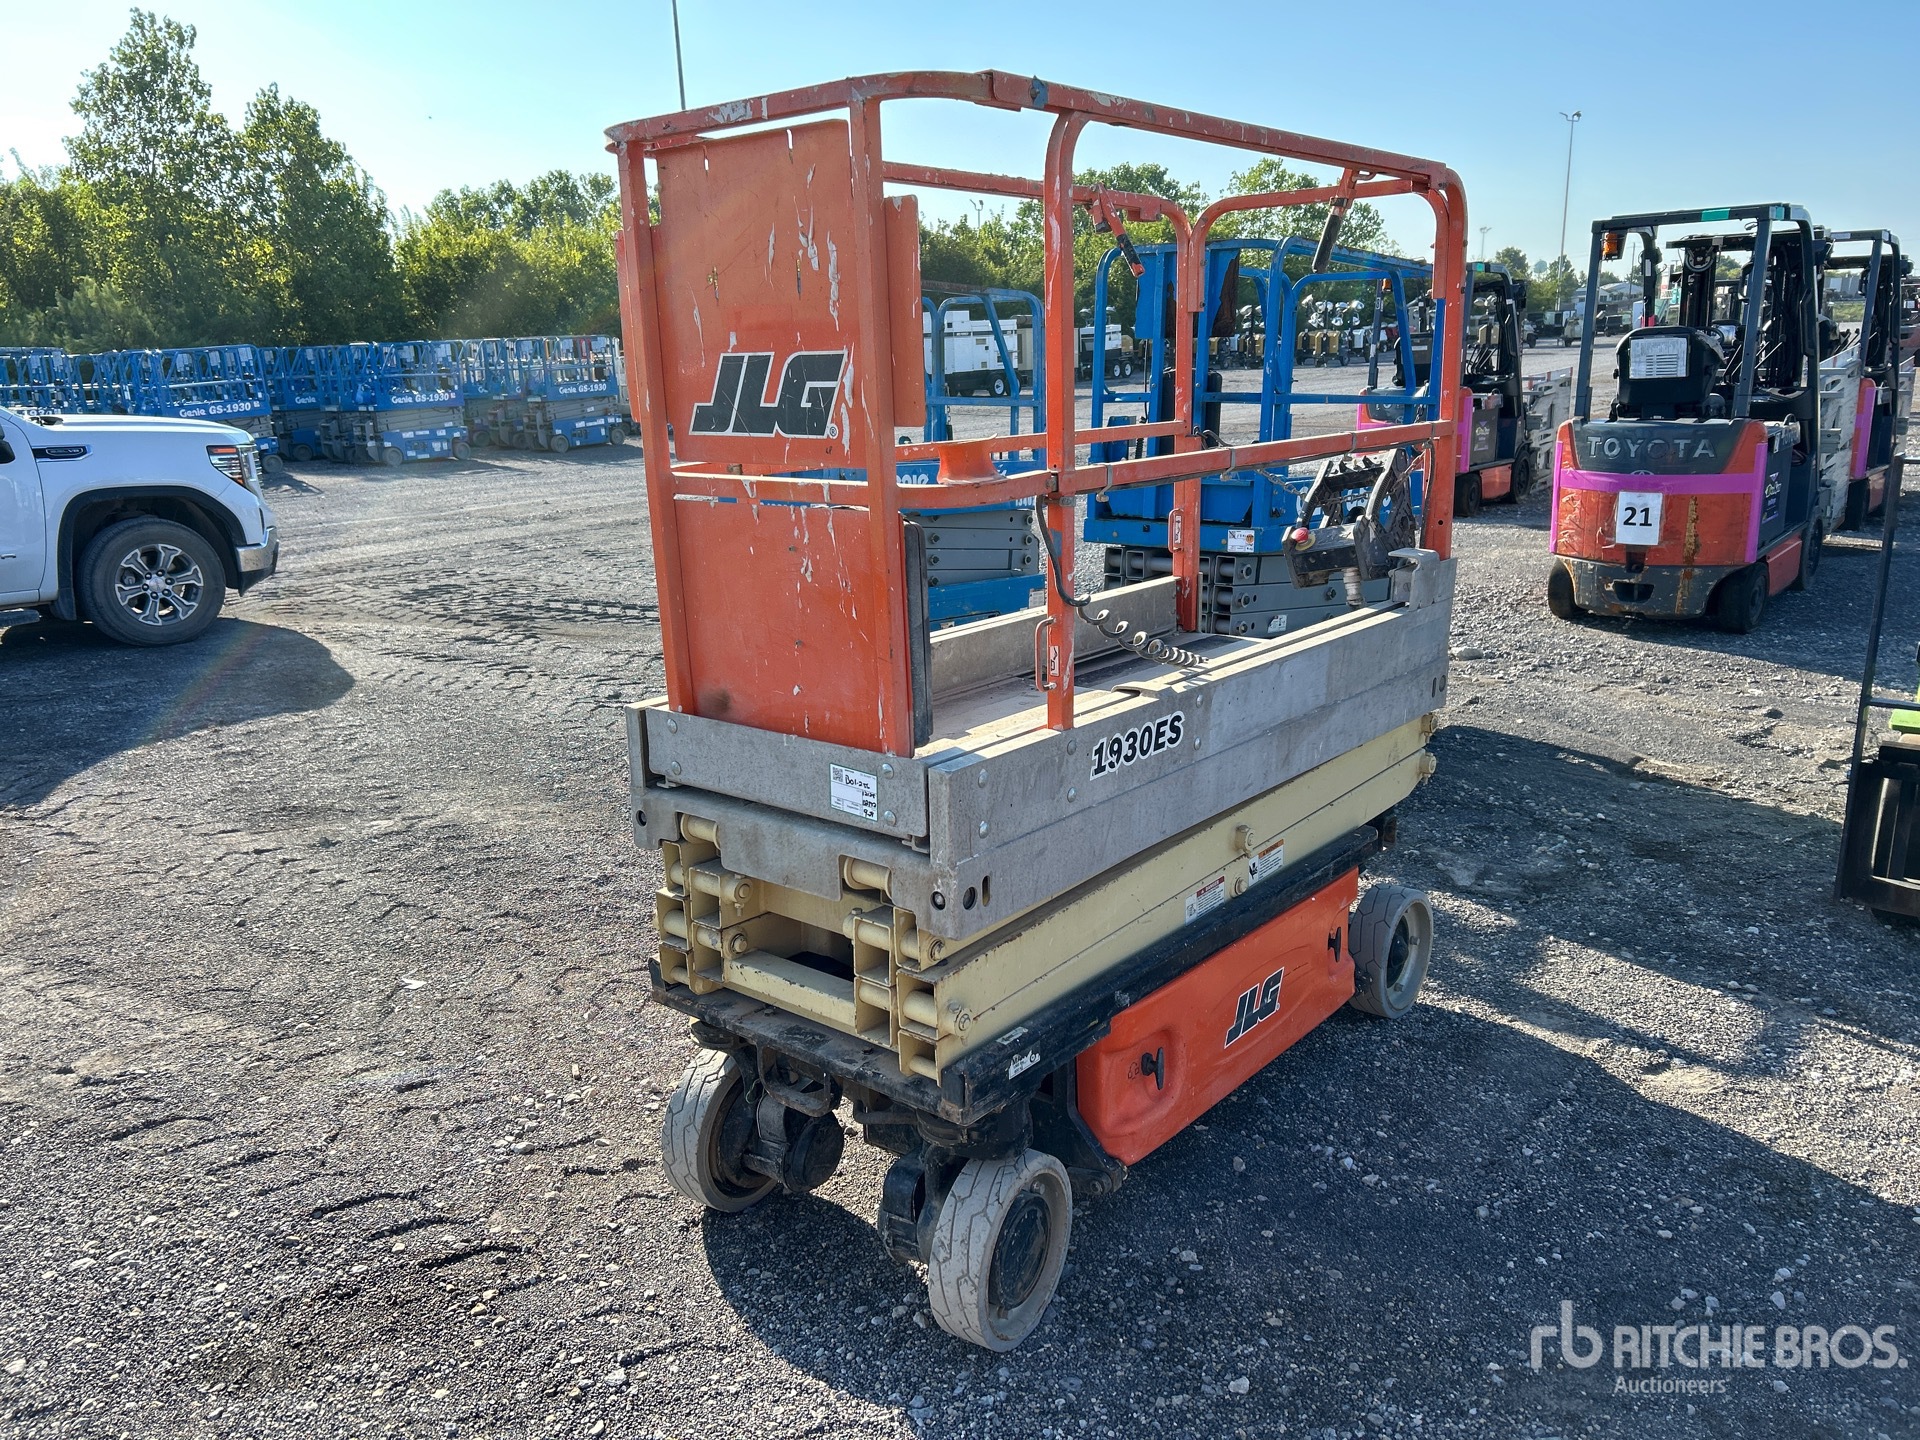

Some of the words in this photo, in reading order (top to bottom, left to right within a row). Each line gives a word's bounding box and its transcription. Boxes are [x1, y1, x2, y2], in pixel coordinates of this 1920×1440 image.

[391, 395, 413, 404] Genie
[415, 393, 449, 403] GS-1930
[559, 386, 577, 395] Genie
[578, 383, 607, 393] GS-1930
[689, 350, 848, 439] JLG
[179, 407, 207, 418] Genie
[209, 402, 251, 415] GS-1930
[295, 396, 316, 404] Genie
[1587, 436, 1716, 459] TOYOTA
[1623, 506, 1653, 527] 21
[1090, 711, 1185, 781] 1930ES
[1224, 967, 1285, 1049] JLG
